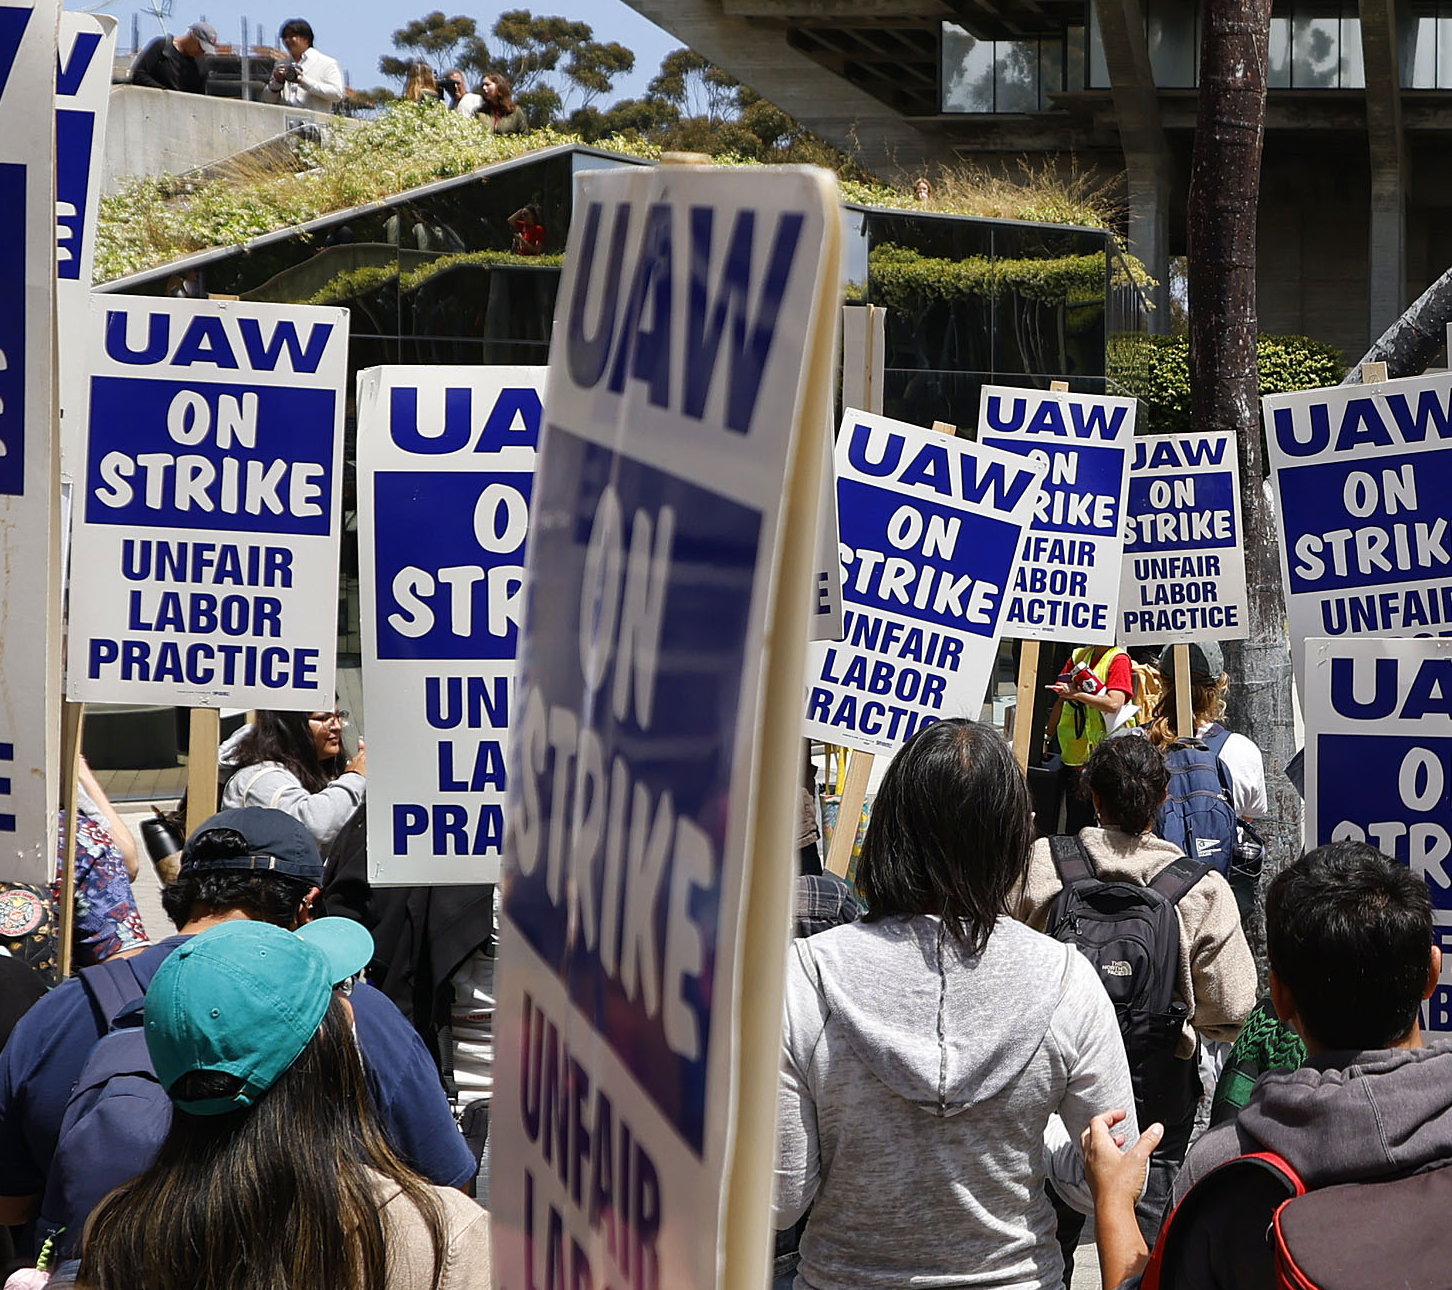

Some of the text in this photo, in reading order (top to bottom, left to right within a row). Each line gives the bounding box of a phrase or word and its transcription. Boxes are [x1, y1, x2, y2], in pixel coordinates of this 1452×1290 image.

[106, 312, 333, 373] UAW
[567, 200, 806, 436] UAW
[167, 390, 258, 448] ON
[390, 388, 545, 454] UA
[987, 396, 1128, 440] UAW
[94, 452, 325, 518] STRIKE
[848, 424, 1036, 512] UAW
[1150, 478, 1195, 509] ON
[1344, 464, 1417, 518] ON
[474, 484, 527, 553] O
[887, 505, 960, 560] ON
[1033, 490, 1116, 528] RIKE
[122, 540, 293, 589] UNFAIR
[1013, 567, 1087, 597] ABOR
[1135, 555, 1220, 580] UNFAIR
[130, 591, 281, 638] LABOR
[388, 565, 522, 638] STR
[579, 485, 672, 728] ON
[1007, 598, 1107, 630] ACTICE
[1124, 606, 1238, 632] PRACTICE
[1141, 582, 1217, 606] LABOR
[89, 640, 319, 689] PRACTICE
[820, 648, 947, 710] LABOR
[514, 684, 716, 1059] STRIKE
